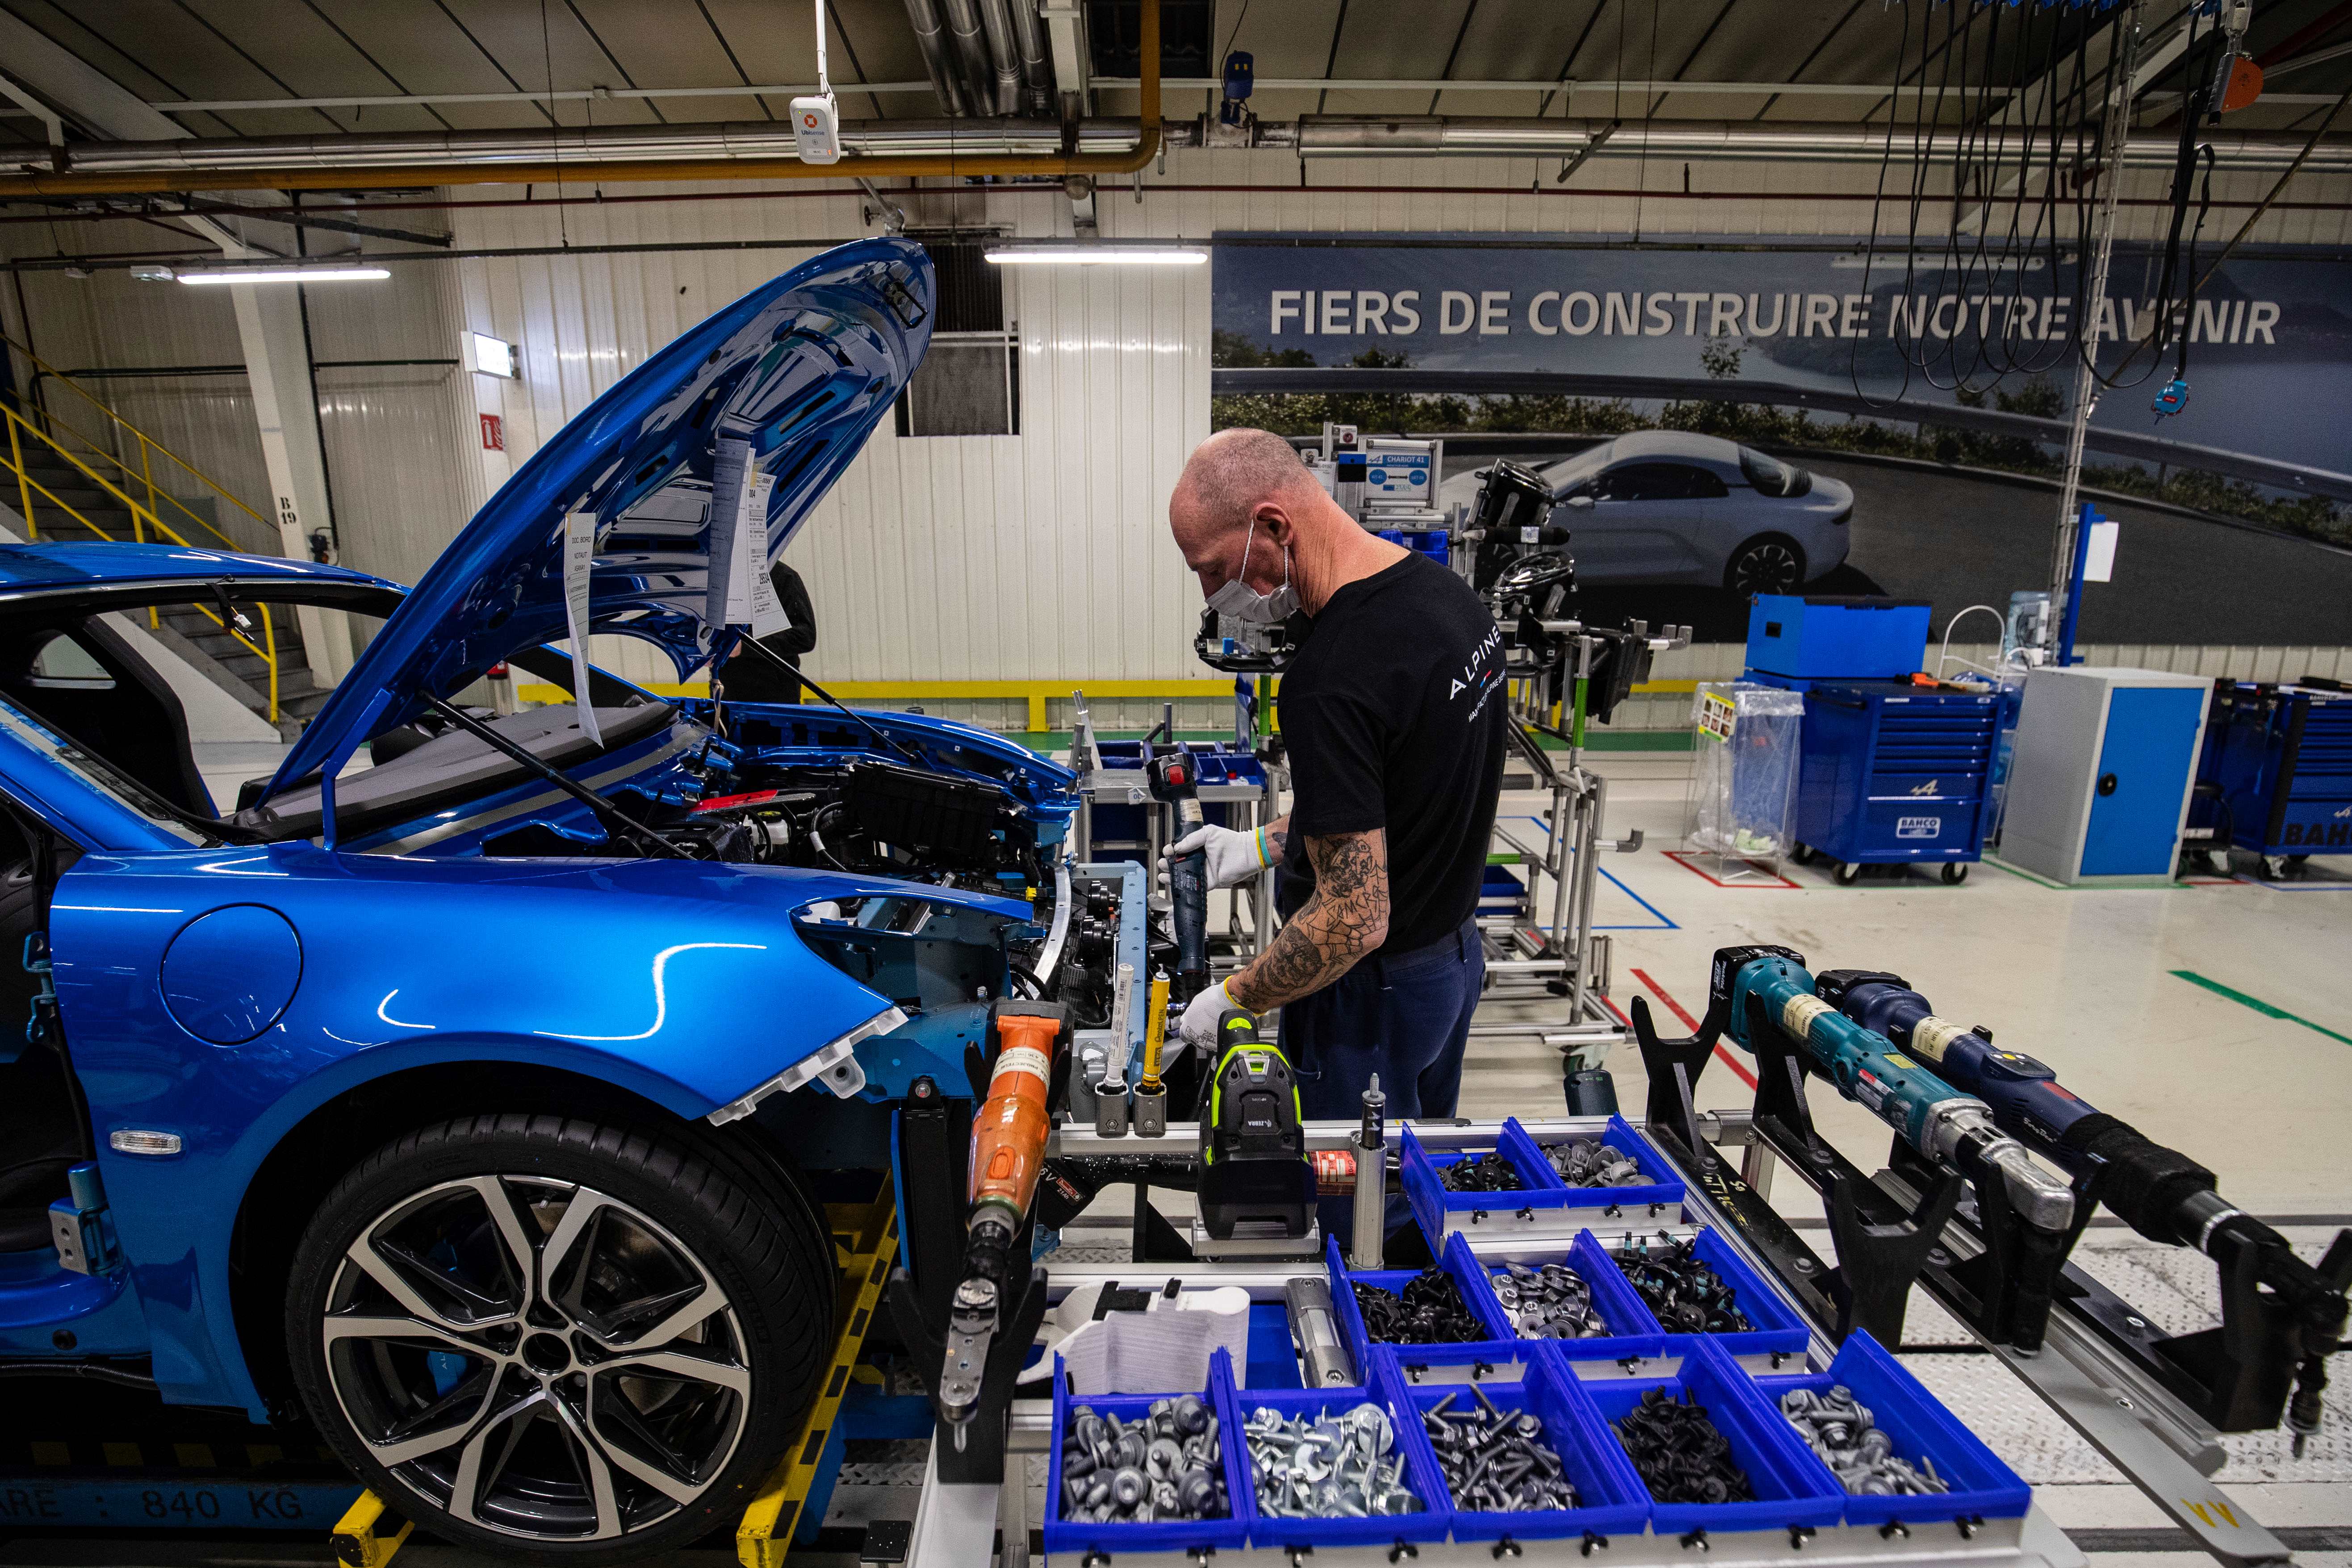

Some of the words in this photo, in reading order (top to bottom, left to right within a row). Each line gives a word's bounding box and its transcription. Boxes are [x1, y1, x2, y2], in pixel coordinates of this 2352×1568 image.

[1270, 290, 1421, 336] FIERS
[1440, 290, 1511, 336] DE
[1528, 290, 1875, 338] CONSTRUIRE
[1887, 294, 2072, 341] NOTRE
[280, 497, 290, 510] B
[281, 512, 297, 524] 19
[1450, 625, 1500, 700] ALPINE
[2284, 824, 2352, 845] BAH
[1000, 1062, 1038, 1070] PROJECTEUR
[0, 1489, 63, 1518] RE
[142, 1490, 221, 1522] 840
[247, 1490, 305, 1520] KG
